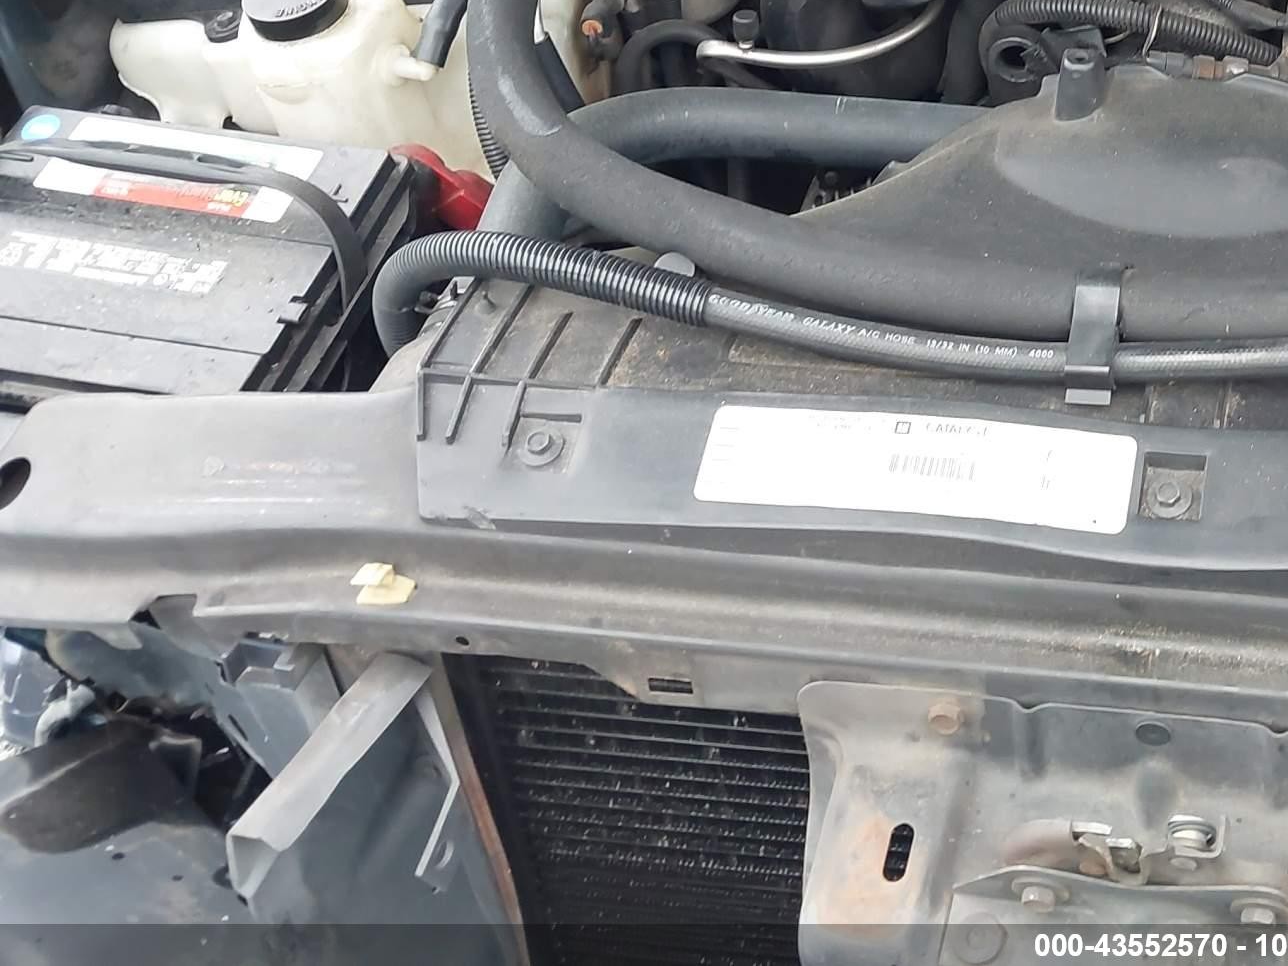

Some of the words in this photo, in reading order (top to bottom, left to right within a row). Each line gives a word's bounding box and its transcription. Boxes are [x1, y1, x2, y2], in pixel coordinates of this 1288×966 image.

[708, 292, 795, 321] GOODYEAR
[802, 315, 857, 337] GALAXY
[958, 342, 971, 353] IN
